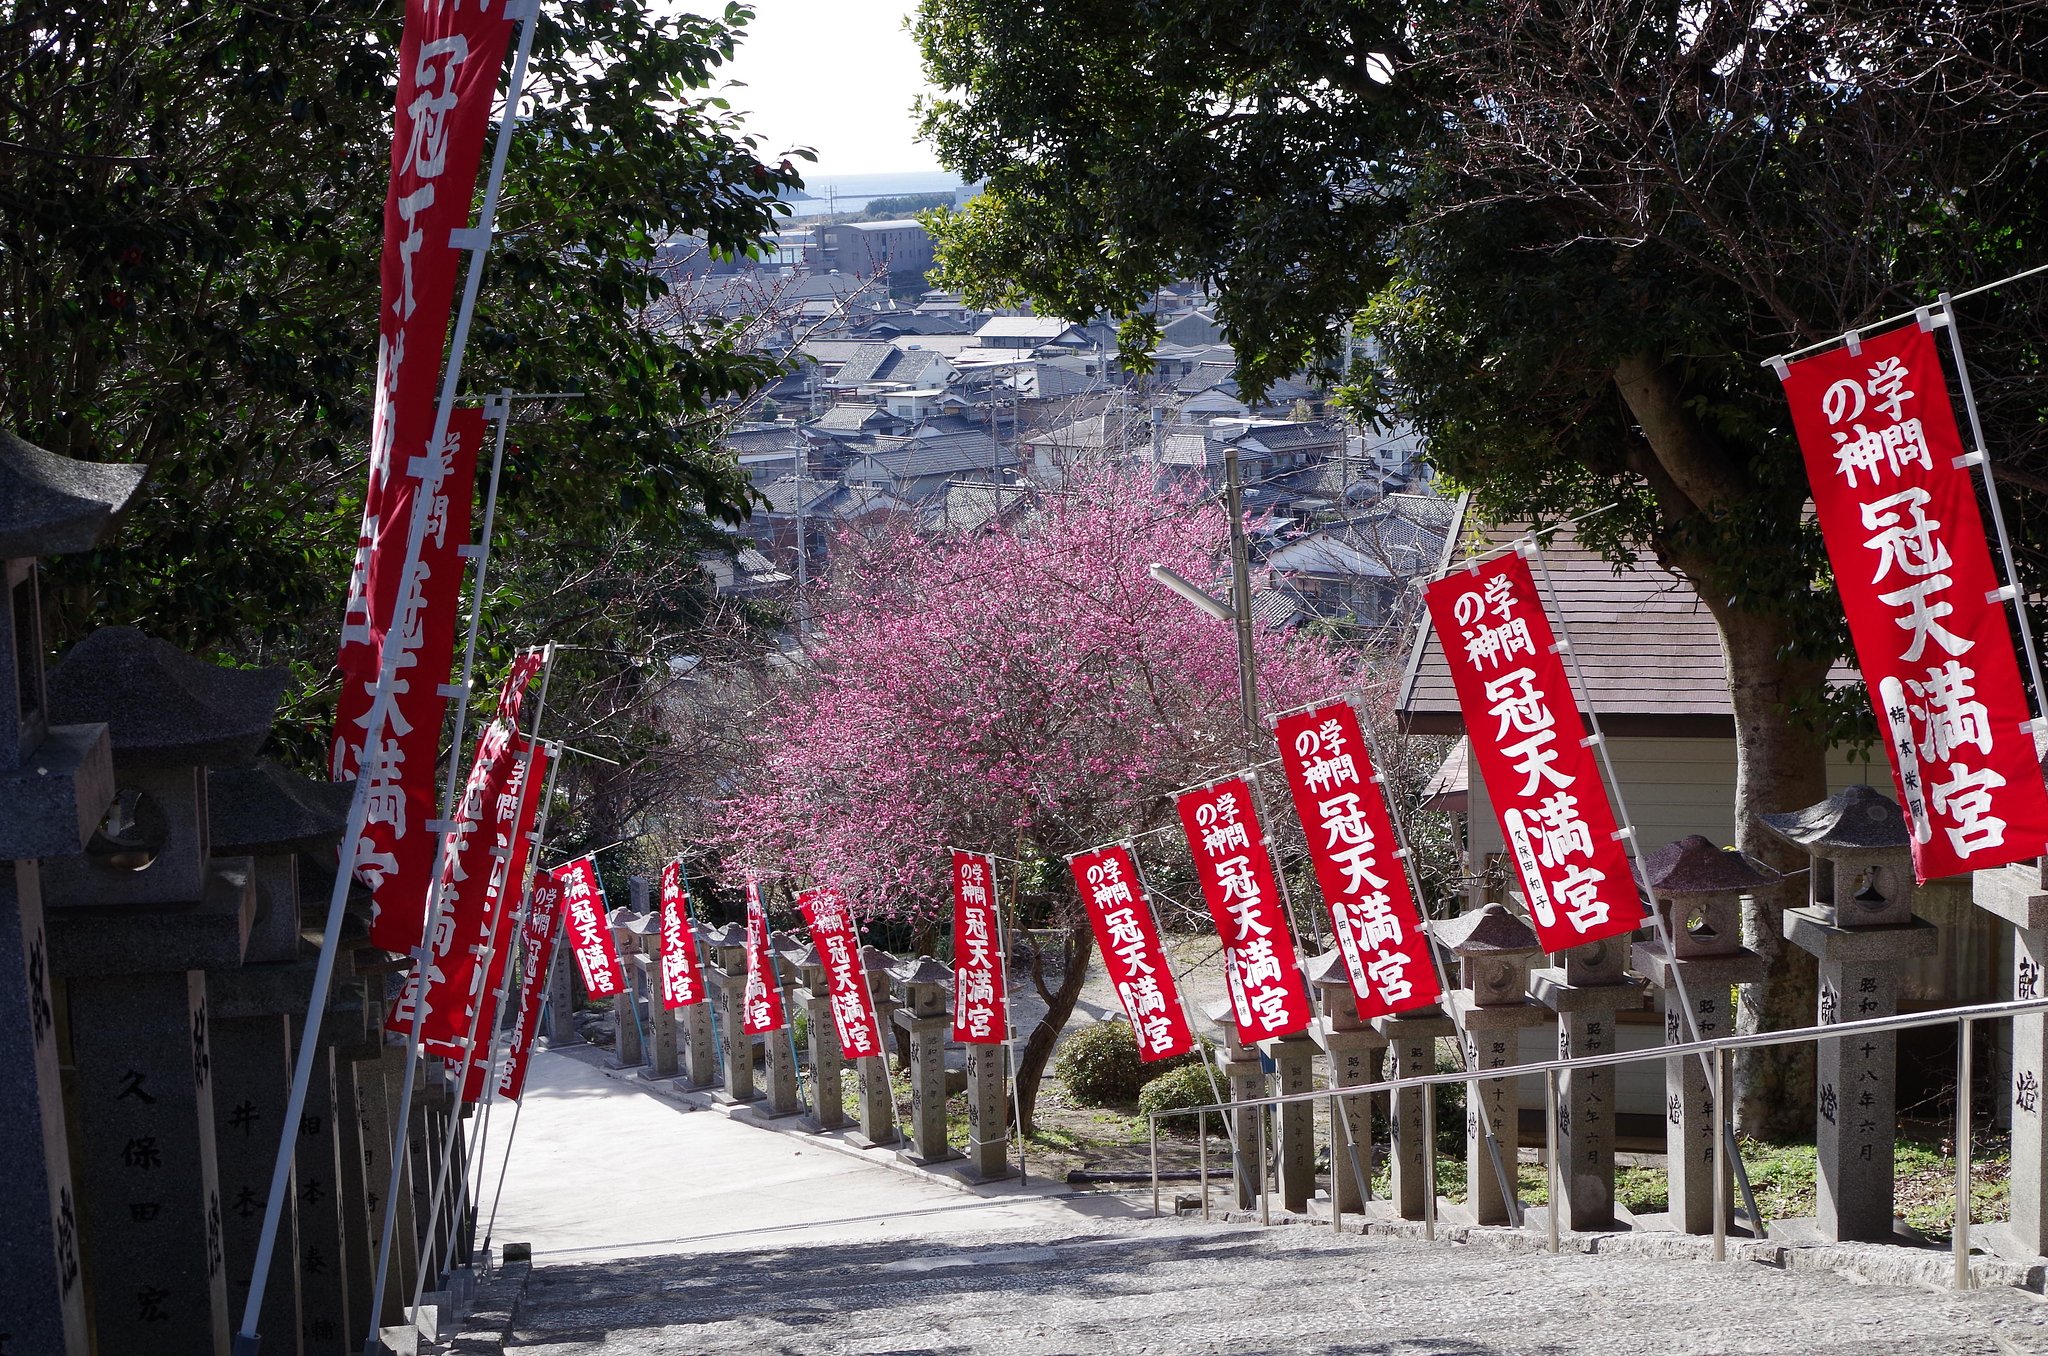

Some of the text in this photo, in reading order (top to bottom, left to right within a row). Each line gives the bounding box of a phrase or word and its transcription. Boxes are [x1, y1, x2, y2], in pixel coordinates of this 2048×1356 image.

[1822, 378, 1880, 488] の神
[1867, 355, 1933, 472] 学問
[1454, 591, 1502, 672] の神
[1484, 573, 1535, 656] 学問
[1860, 487, 2007, 859] 冠天満宮
[1296, 729, 1332, 793] の神
[1320, 719, 1359, 784] 学問
[1484, 668, 1610, 934] 冠天満宮
[1196, 803, 1228, 857] の神
[1217, 792, 1250, 851] 学問
[1514, 830, 1547, 910] 久保田和子
[961, 864, 974, 904] の神
[972, 864, 987, 906] 学問
[1087, 865, 1114, 909] の神
[1103, 858, 1132, 902] 学問
[1318, 792, 1413, 1005] 冠天満宮
[571, 900, 614, 992] 冠天満宮
[664, 902, 693, 1003] 冠天満宮
[826, 936, 871, 1052] 冠天満宮
[965, 907, 994, 1037] 冠天満宮
[1105, 907, 1174, 1054] 冠天満宮
[1216, 856, 1289, 1032] 冠天満宮
[1292, 1066, 1305, 1164] 昭和十八年六月
[1347, 1056, 1360, 1148] 昭和十八年
[1410, 1048, 1424, 1165] 昭和十八年六月
[1490, 1043, 1505, 1150] 昭和十八年
[1586, 1022, 1602, 1164] 昭和十八年六月
[1700, 1000, 1715, 1163] 昭和年六月
[1859, 977, 1879, 1162] 昭和十八年六月
